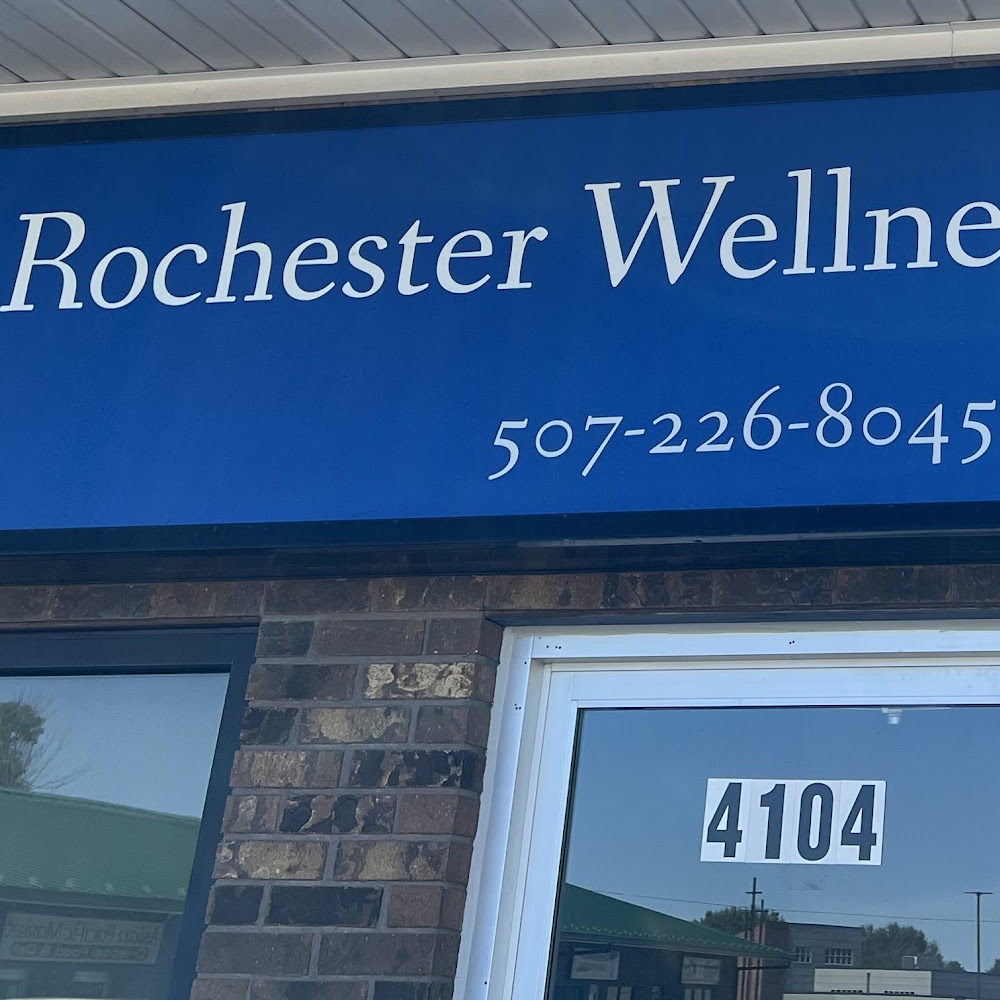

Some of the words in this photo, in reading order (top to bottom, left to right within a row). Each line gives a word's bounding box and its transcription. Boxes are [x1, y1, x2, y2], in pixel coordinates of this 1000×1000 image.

[0, 202, 549, 311] Rochester
[488, 383, 997, 480] 507-226-8045
[706, 782, 878, 862] 4104
